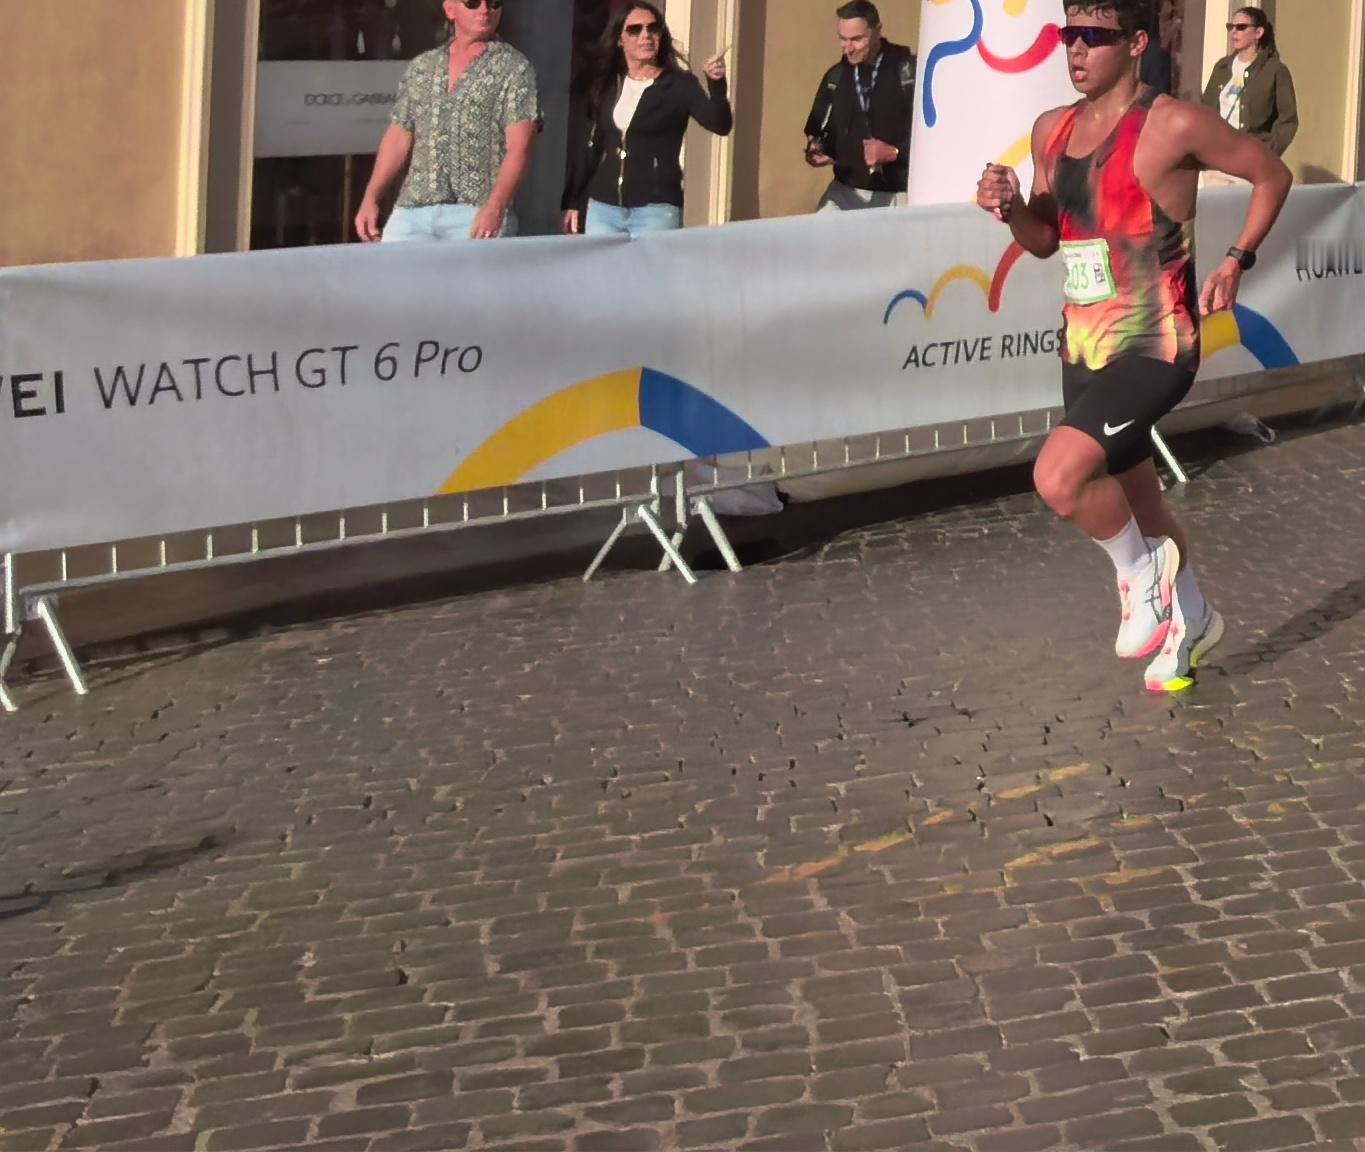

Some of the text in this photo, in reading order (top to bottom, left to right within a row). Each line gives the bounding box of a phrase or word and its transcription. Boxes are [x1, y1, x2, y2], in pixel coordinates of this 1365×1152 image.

[353, 92, 398, 107] GABBA
[1066, 263, 1089, 290] 03
[902, 336, 993, 370] ACTIVE
[0, 339, 484, 419] EI WATCH GT 6 Pro
